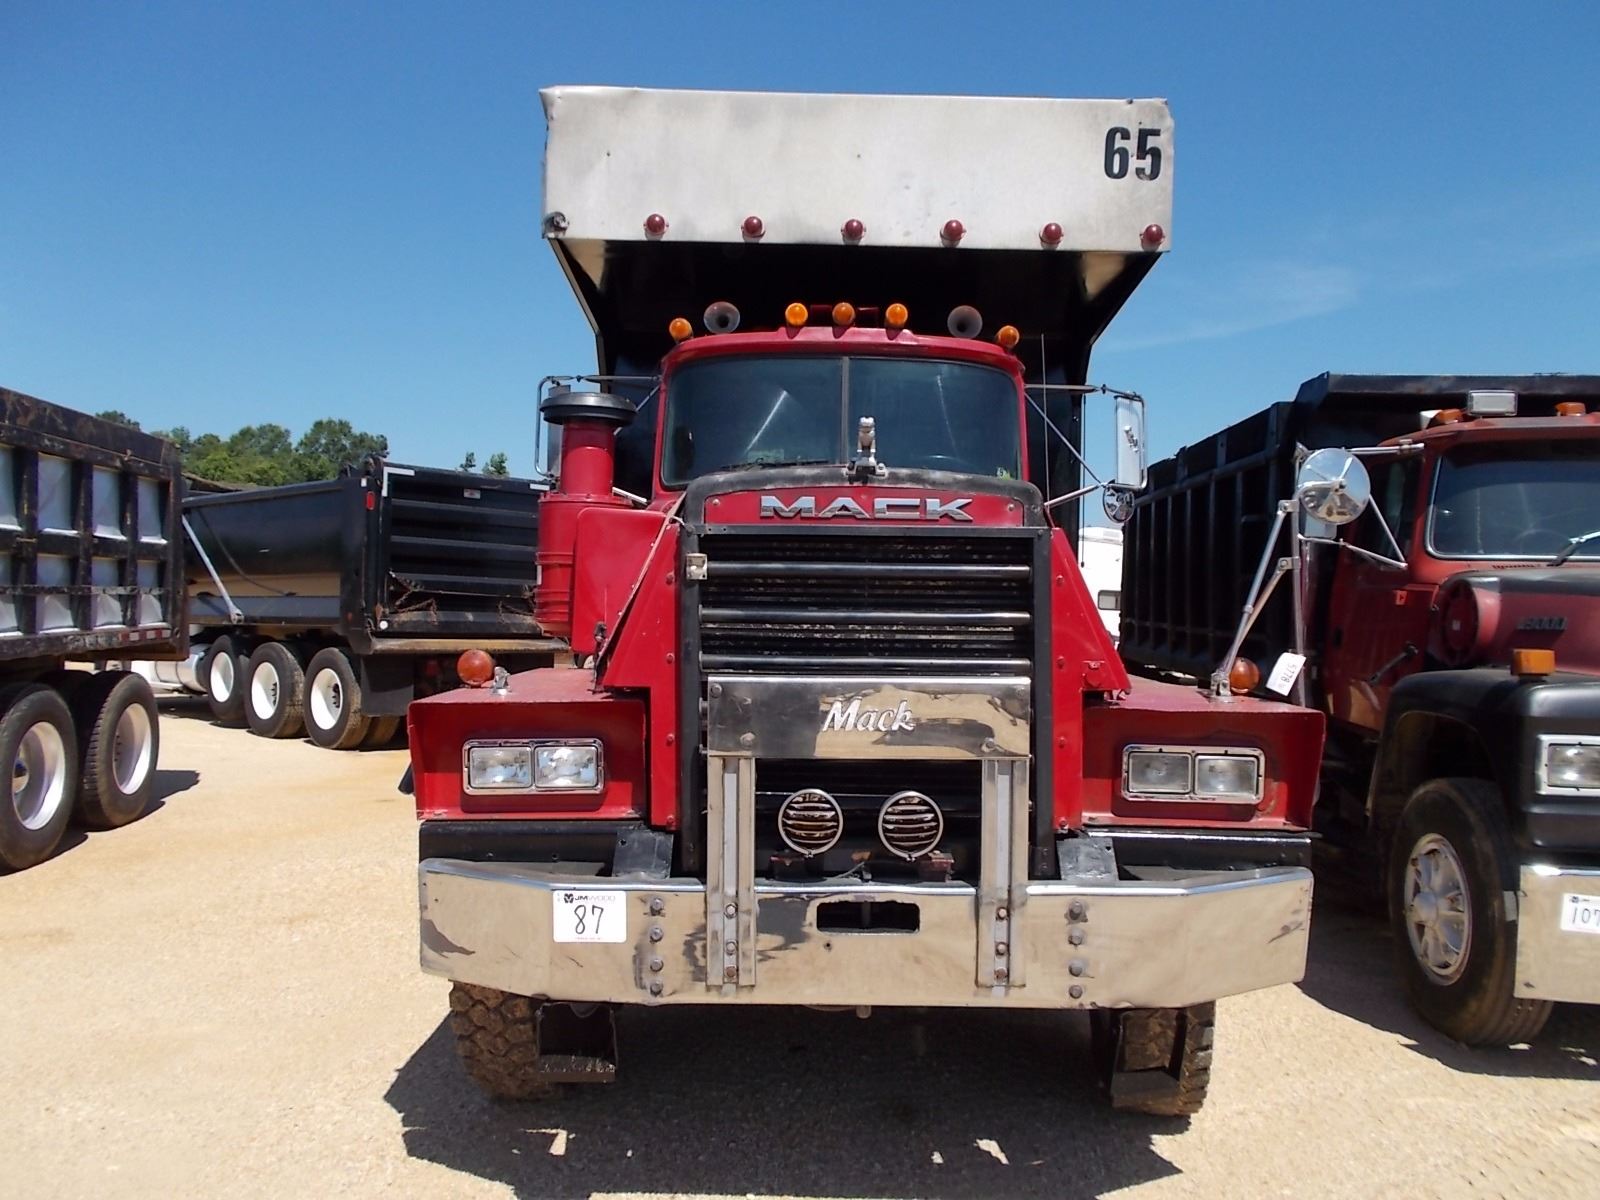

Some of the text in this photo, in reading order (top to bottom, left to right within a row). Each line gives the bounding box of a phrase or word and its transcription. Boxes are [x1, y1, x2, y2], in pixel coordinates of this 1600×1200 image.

[1104, 127, 1162, 181] 65
[760, 495, 973, 521] MACK
[822, 697, 916, 732] Mack
[574, 904, 604, 934] 87
